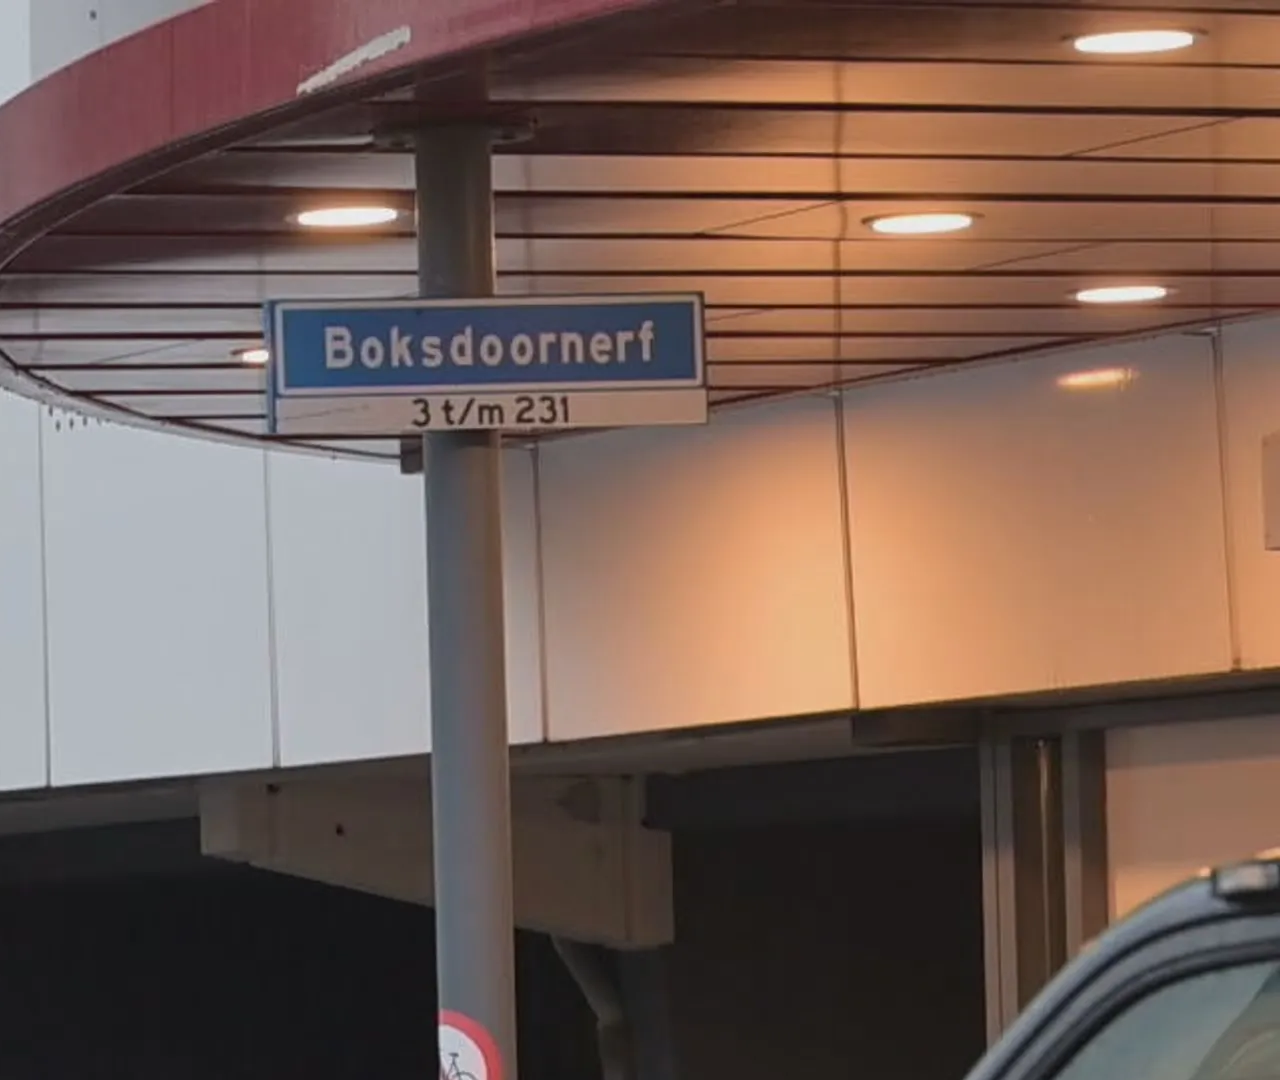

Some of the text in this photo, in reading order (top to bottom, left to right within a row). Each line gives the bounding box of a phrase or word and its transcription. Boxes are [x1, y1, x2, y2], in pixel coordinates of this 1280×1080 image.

[324, 320, 654, 369] Boksdoornerf
[412, 395, 571, 427] 3 t/m 231
